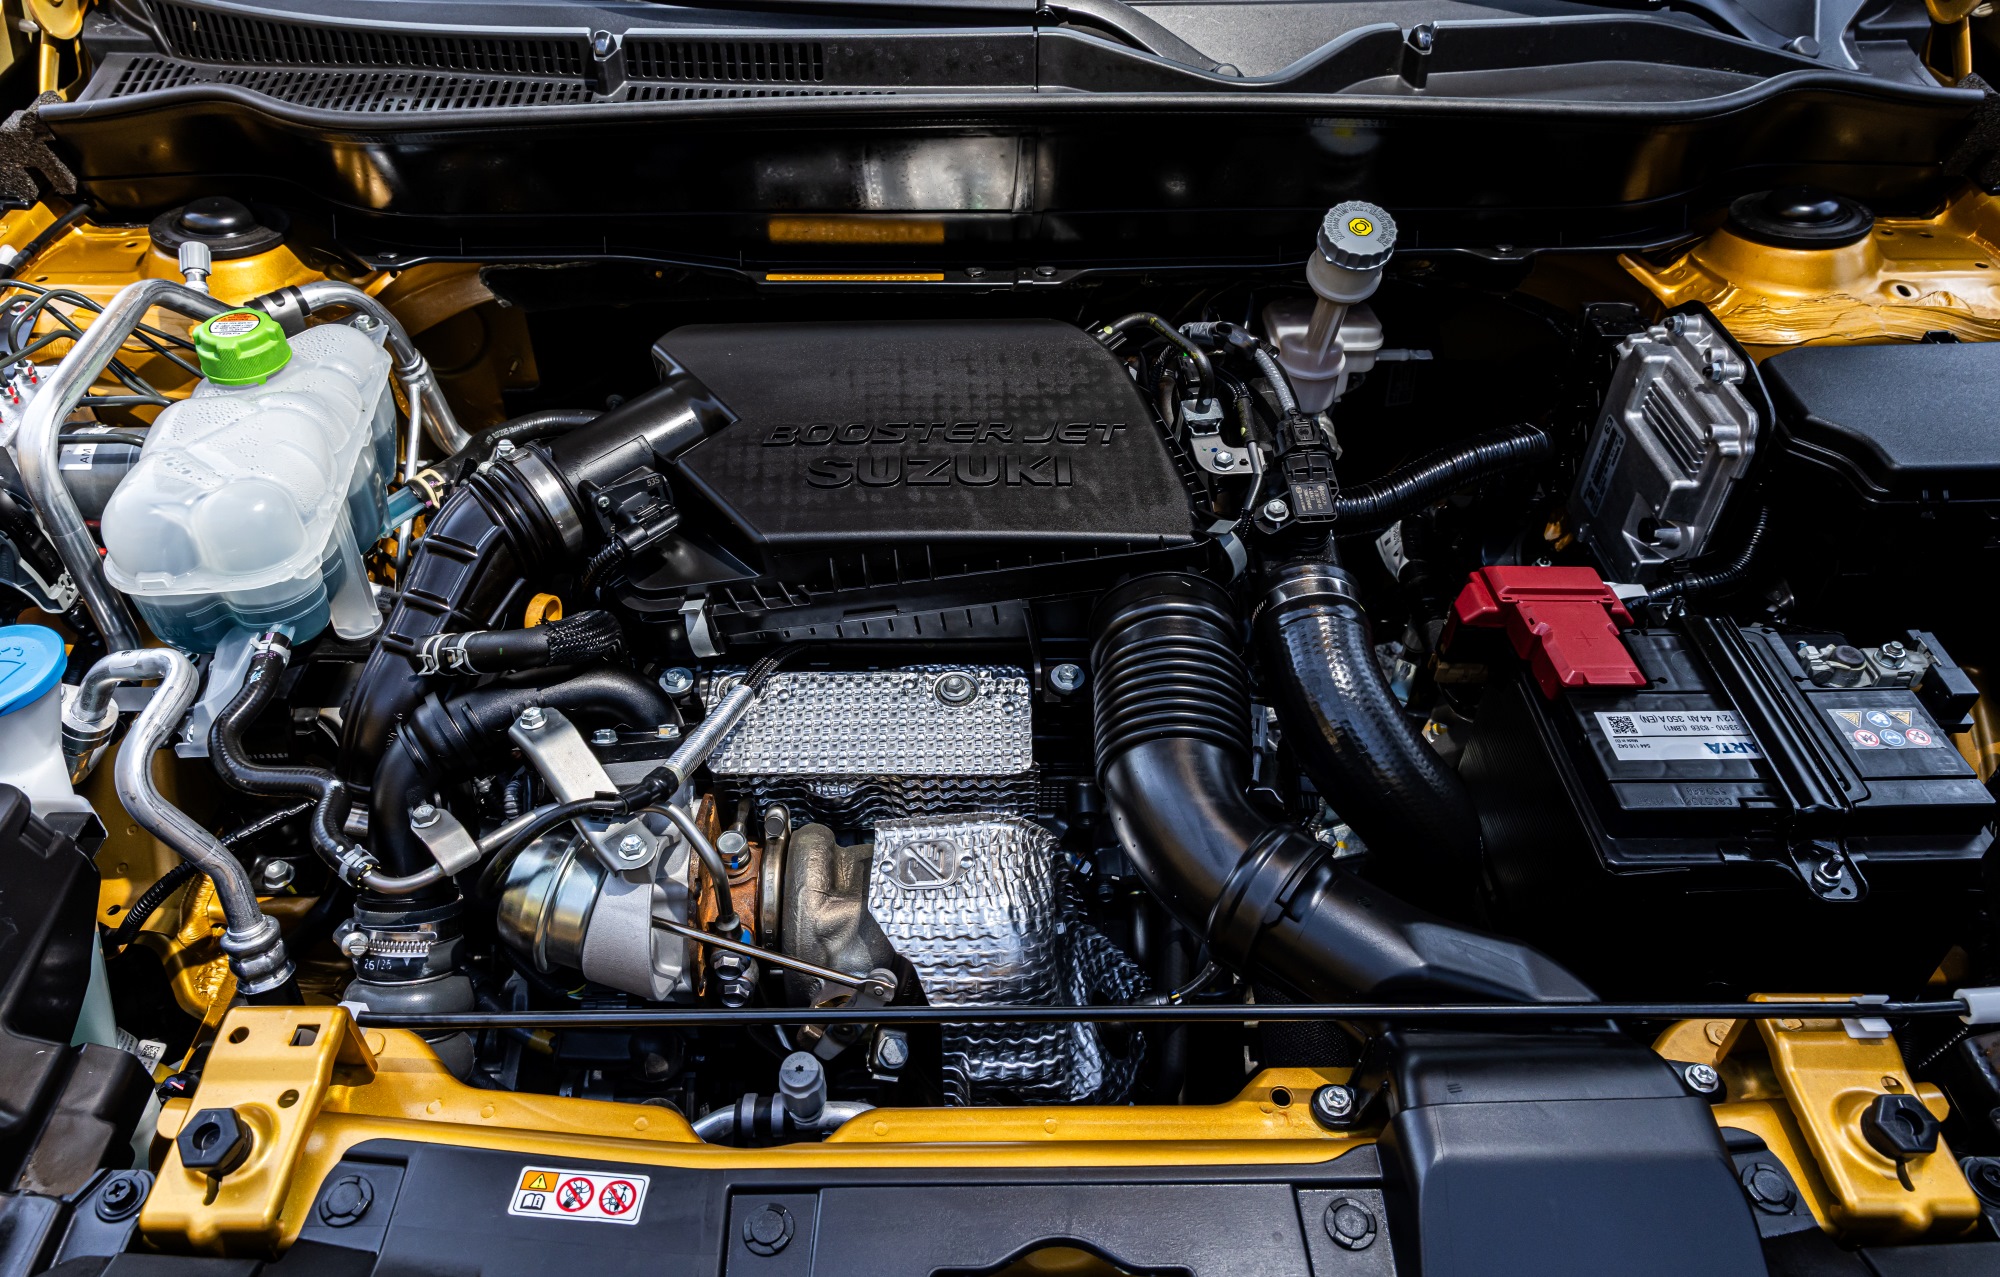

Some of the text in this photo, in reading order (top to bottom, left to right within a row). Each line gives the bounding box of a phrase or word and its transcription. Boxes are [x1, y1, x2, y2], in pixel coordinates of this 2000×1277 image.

[805, 454, 1074, 489] SUZUKI
[1666, 715, 1685, 723] 350
[1703, 742, 1759, 754] ARTA
